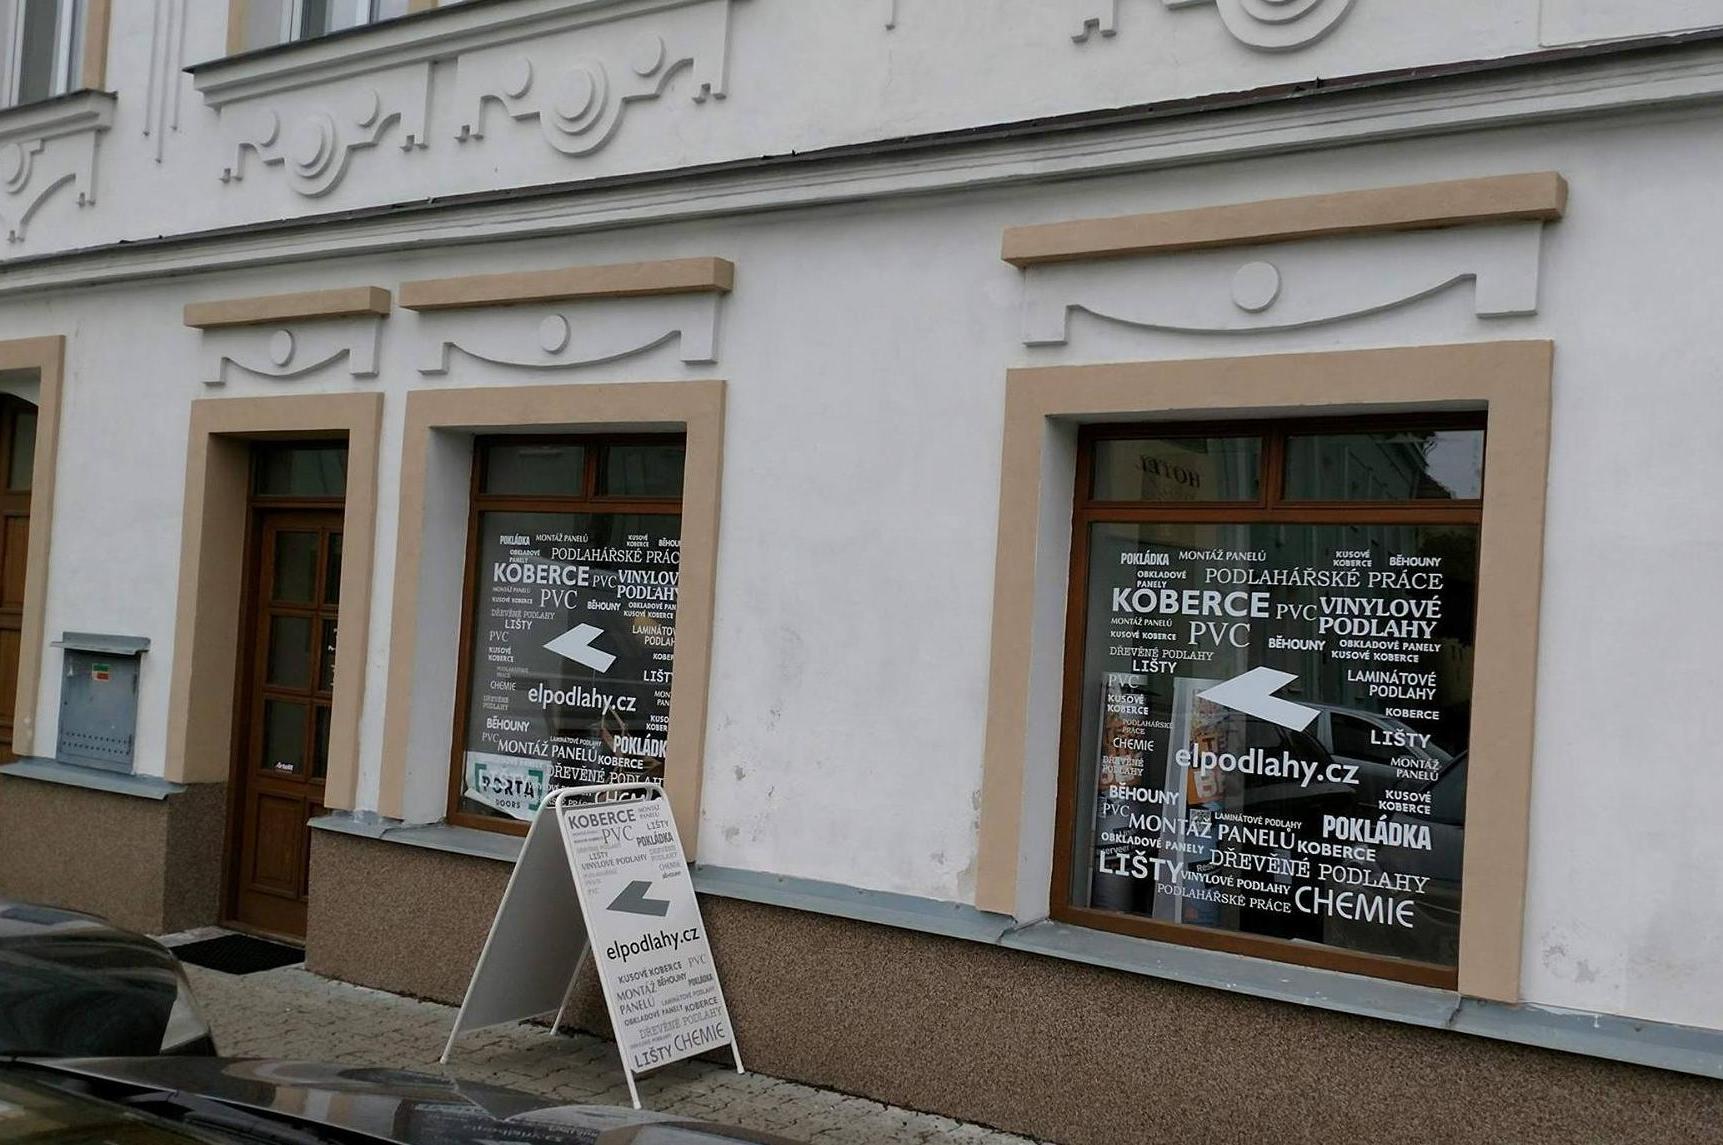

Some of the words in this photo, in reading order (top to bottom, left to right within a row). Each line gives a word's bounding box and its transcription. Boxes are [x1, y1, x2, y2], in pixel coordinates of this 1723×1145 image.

[535, 533, 563, 543] MONTÁŽ
[658, 537, 681, 548] BĚHOU
[551, 546, 642, 563] PODLAHÁŘSKÉ
[646, 548, 680, 564] PRÁC
[1120, 550, 1170, 566] POKLÁDKA
[1178, 549, 1224, 561] MONTÁŽ
[1226, 550, 1266, 562] PANELŮ
[1336, 550, 1370, 558] KUSOVÉ
[1390, 554, 1442, 567] BĚHOUNY
[1333, 559, 1372, 568] KOBERCE
[493, 562, 590, 586] KOBERCE
[592, 575, 617, 588] PVC
[618, 569, 679, 586] VINYLOV
[1137, 570, 1187, 580] OBKLADOVÉ
[1205, 567, 1360, 588] PODLAHÁŘSKÉ
[1368, 568, 1444, 590] PRÁCE
[1136, 580, 1167, 589] PANELY
[540, 588, 578, 610] PVC
[587, 599, 621, 611] BĚHOUNY
[1112, 587, 1271, 618] KOBERCE
[1319, 595, 1442, 619] VINYLOVÉ
[1276, 603, 1318, 621] PVC
[504, 618, 532, 630] LIŠTY
[632, 624, 675, 636] LAMINÁTO
[1110, 616, 1143, 627] MONTÁŽ
[1144, 618, 1173, 628] PANELŮ
[1318, 616, 1438, 639] PODLAHY
[490, 630, 509, 642] PVC
[644, 636, 675, 646] PODLAH
[1110, 630, 1140, 640] KUSOVÉ
[1142, 632, 1177, 641] KOBERCE
[1188, 621, 1250, 648] PVC
[1268, 635, 1326, 651] BĚHOUNY
[1339, 639, 1400, 650] OBKLADOVÉ
[1402, 642, 1442, 652] PANELY
[1109, 646, 1159, 658] DŘEVĚNÉ
[1162, 649, 1215, 662] PODLAHY
[1332, 650, 1370, 660] KUSOVÉ
[1374, 652, 1420, 664] KOBERCE
[1132, 658, 1178, 674] LIŠTY
[644, 669, 673, 683] LIŠT
[1108, 674, 1140, 688] PVC
[1348, 669, 1437, 686] LAMINÁTOVÉ
[490, 680, 516, 691] CHEMIE
[1369, 684, 1437, 700] PODLAHY
[528, 682, 637, 715] elpodlahy.cz
[654, 690, 671, 698] MON
[1108, 694, 1145, 705] KUSOVÉ
[650, 714, 670, 722] KUSO
[1107, 704, 1149, 716] KOBERCE
[1385, 707, 1440, 720] KOBERCE
[486, 716, 530, 732] BĚHOUNY
[646, 723, 668, 732] KOBER
[482, 732, 500, 743] PVC
[613, 733, 668, 758] POKLÁDK
[1112, 737, 1154, 752] CHEMIE
[1370, 728, 1432, 749] LIŠTY
[498, 739, 548, 757] MONTÁŽ
[552, 744, 598, 762] PANELŮ
[598, 754, 644, 770] KOBERCE
[1175, 743, 1360, 788] elpodlahy.cz
[1390, 756, 1440, 770] MONTÁŽ
[1396, 769, 1439, 782] PANELŮ
[482, 775, 535, 798] PORTA
[1109, 783, 1180, 806] BĚHOUNY
[1385, 790, 1432, 804] KUSOVÉ
[1102, 803, 1130, 818] PVC
[1378, 800, 1432, 815] KOBERCE
[568, 809, 636, 829] KOBERCE
[1214, 812, 1263, 826] LAMINÁTOVÉ
[1264, 818, 1303, 830] PODLAHY
[602, 825, 636, 844] PVC
[636, 831, 674, 847] POKLÁDKA
[1128, 813, 1212, 839] MONTÁŽ
[1218, 824, 1296, 850] PANELŮ
[1322, 814, 1432, 850] POKLÁDKA
[1102, 832, 1162, 850] OBKLADOVÉ
[1165, 840, 1205, 854] PANELY
[1297, 840, 1376, 862] KOBERCE
[1099, 850, 1184, 884] LIŠTY
[1209, 847, 1310, 878] DŘEVĚNÉ
[1318, 863, 1430, 894] PODLAHY
[1181, 870, 1234, 887] VINYLOVÉ
[1236, 879, 1292, 895] PODLAHY
[1157, 882, 1246, 907] PODLAHÁŘSKÉ
[1250, 897, 1292, 914] PRÁCE
[1294, 886, 1414, 928] CHEMIE
[606, 927, 700, 962] elpodlahy.cz
[650, 961, 682, 977] KOBERCE
[688, 954, 706, 968] PVC
[616, 980, 658, 1001] MONTÁŽ
[634, 1044, 672, 1068] LIŠTY
[674, 1022, 726, 1052] CHEMIE
